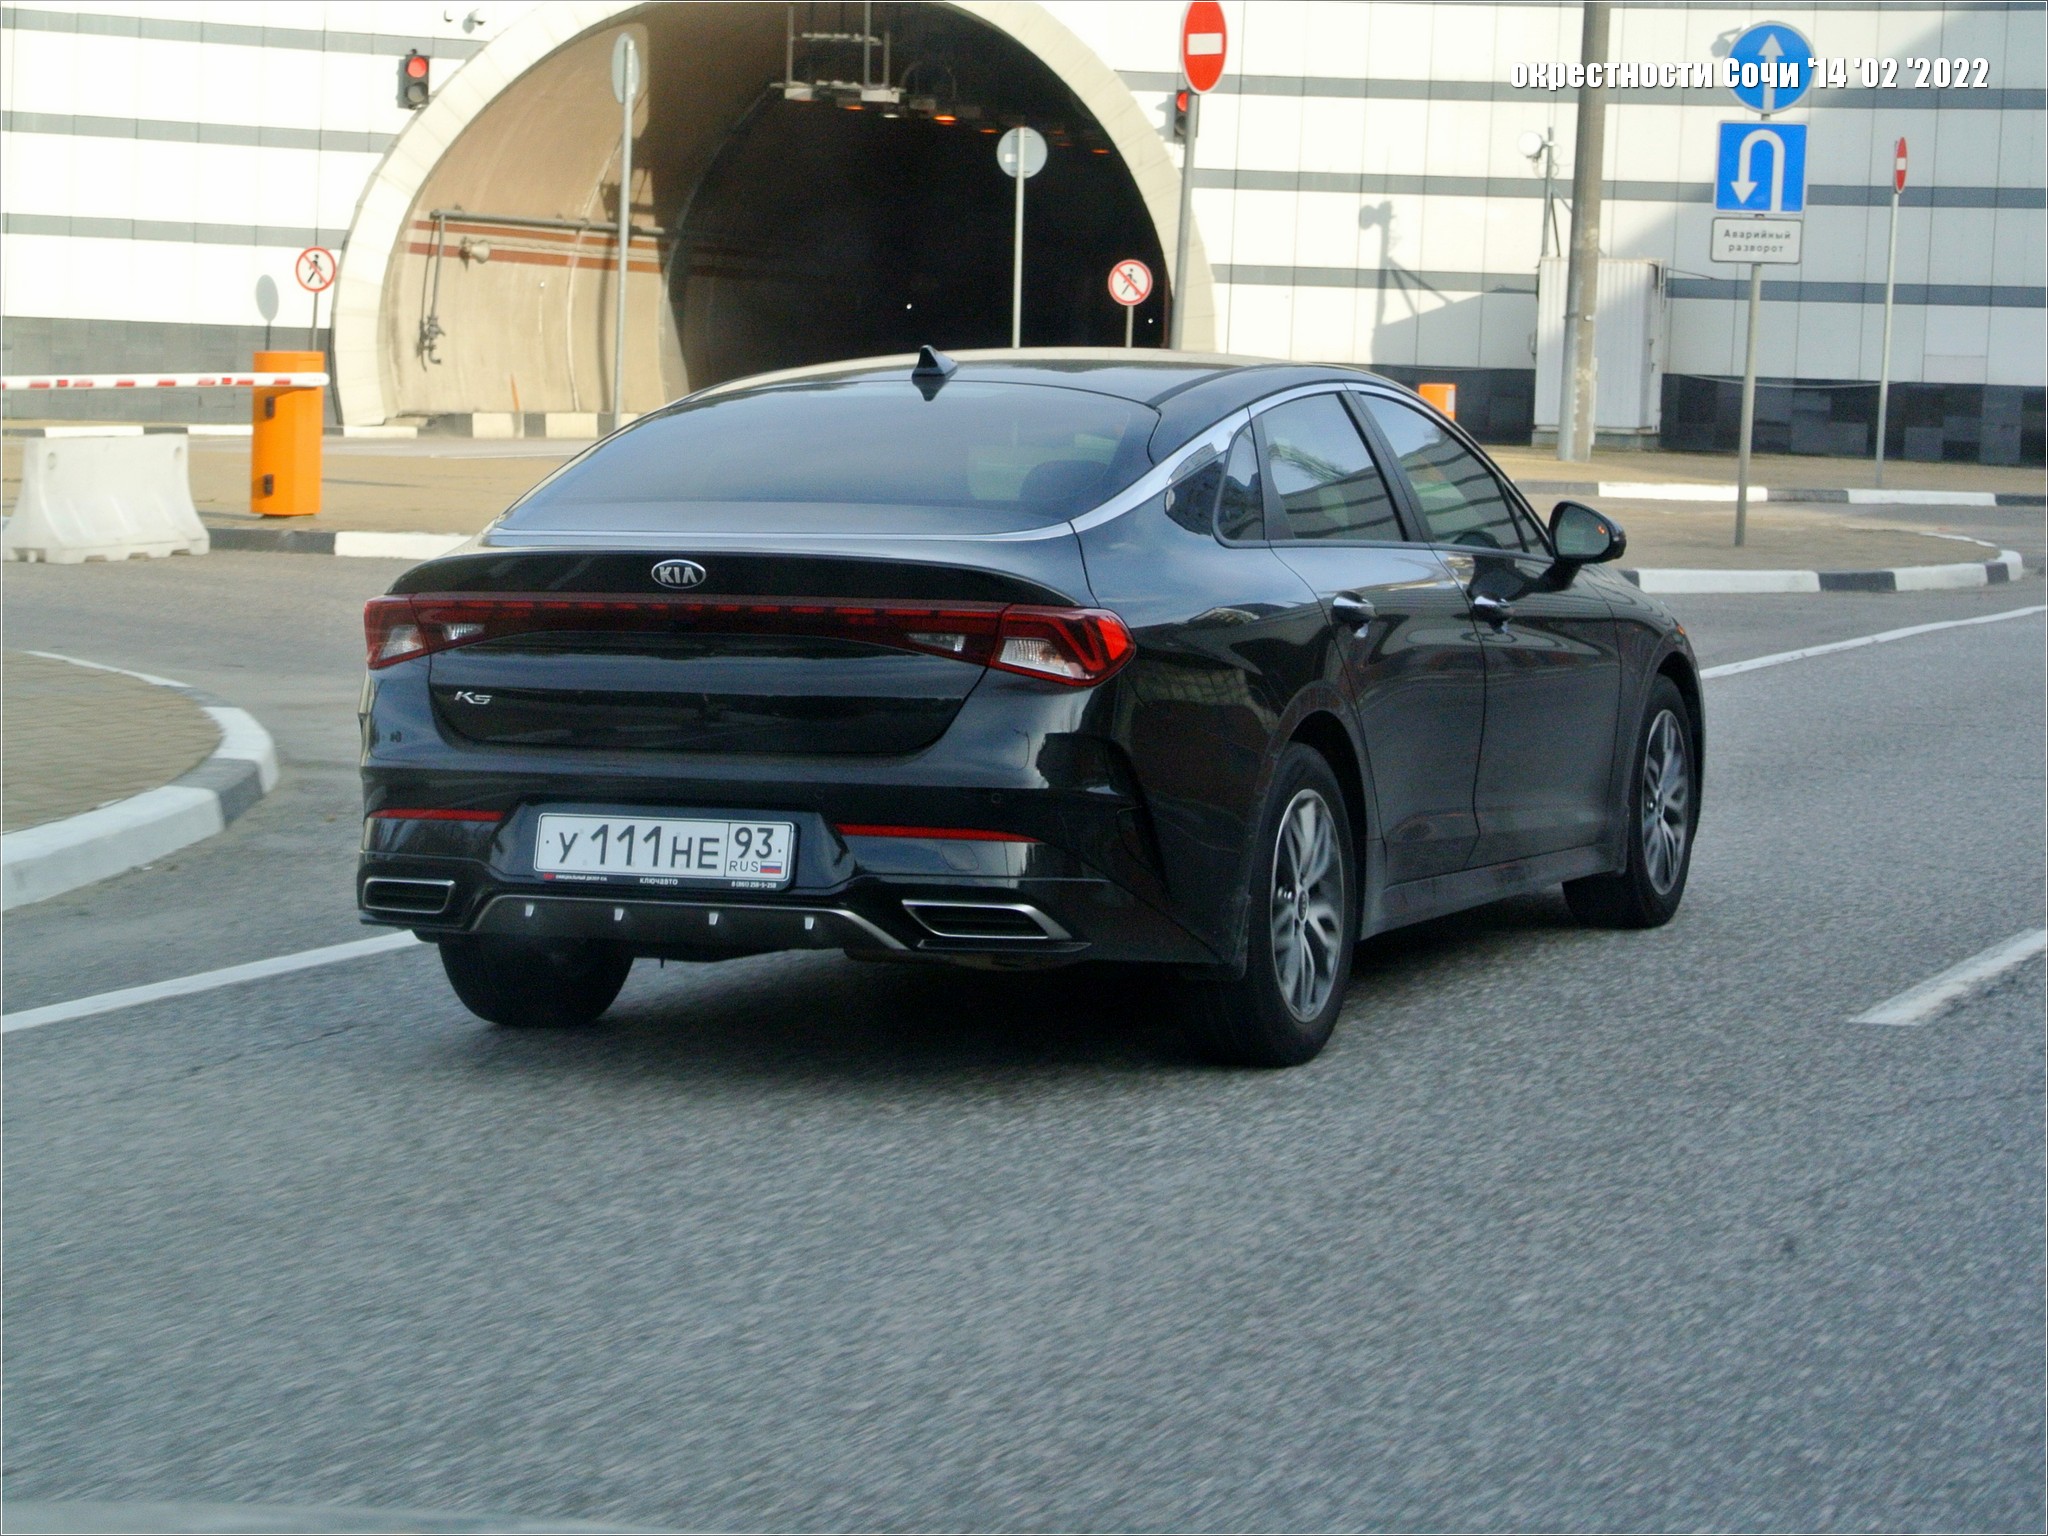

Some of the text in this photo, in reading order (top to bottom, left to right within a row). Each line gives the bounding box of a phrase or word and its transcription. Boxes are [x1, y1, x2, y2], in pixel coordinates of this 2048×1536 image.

[1724, 229, 1791, 239] Аварийный
[1728, 244, 1784, 253] разворот
[659, 566, 698, 584] KIA
[454, 691, 493, 705] K5
[734, 827, 774, 859] 93
[729, 861, 759, 873] RUS
